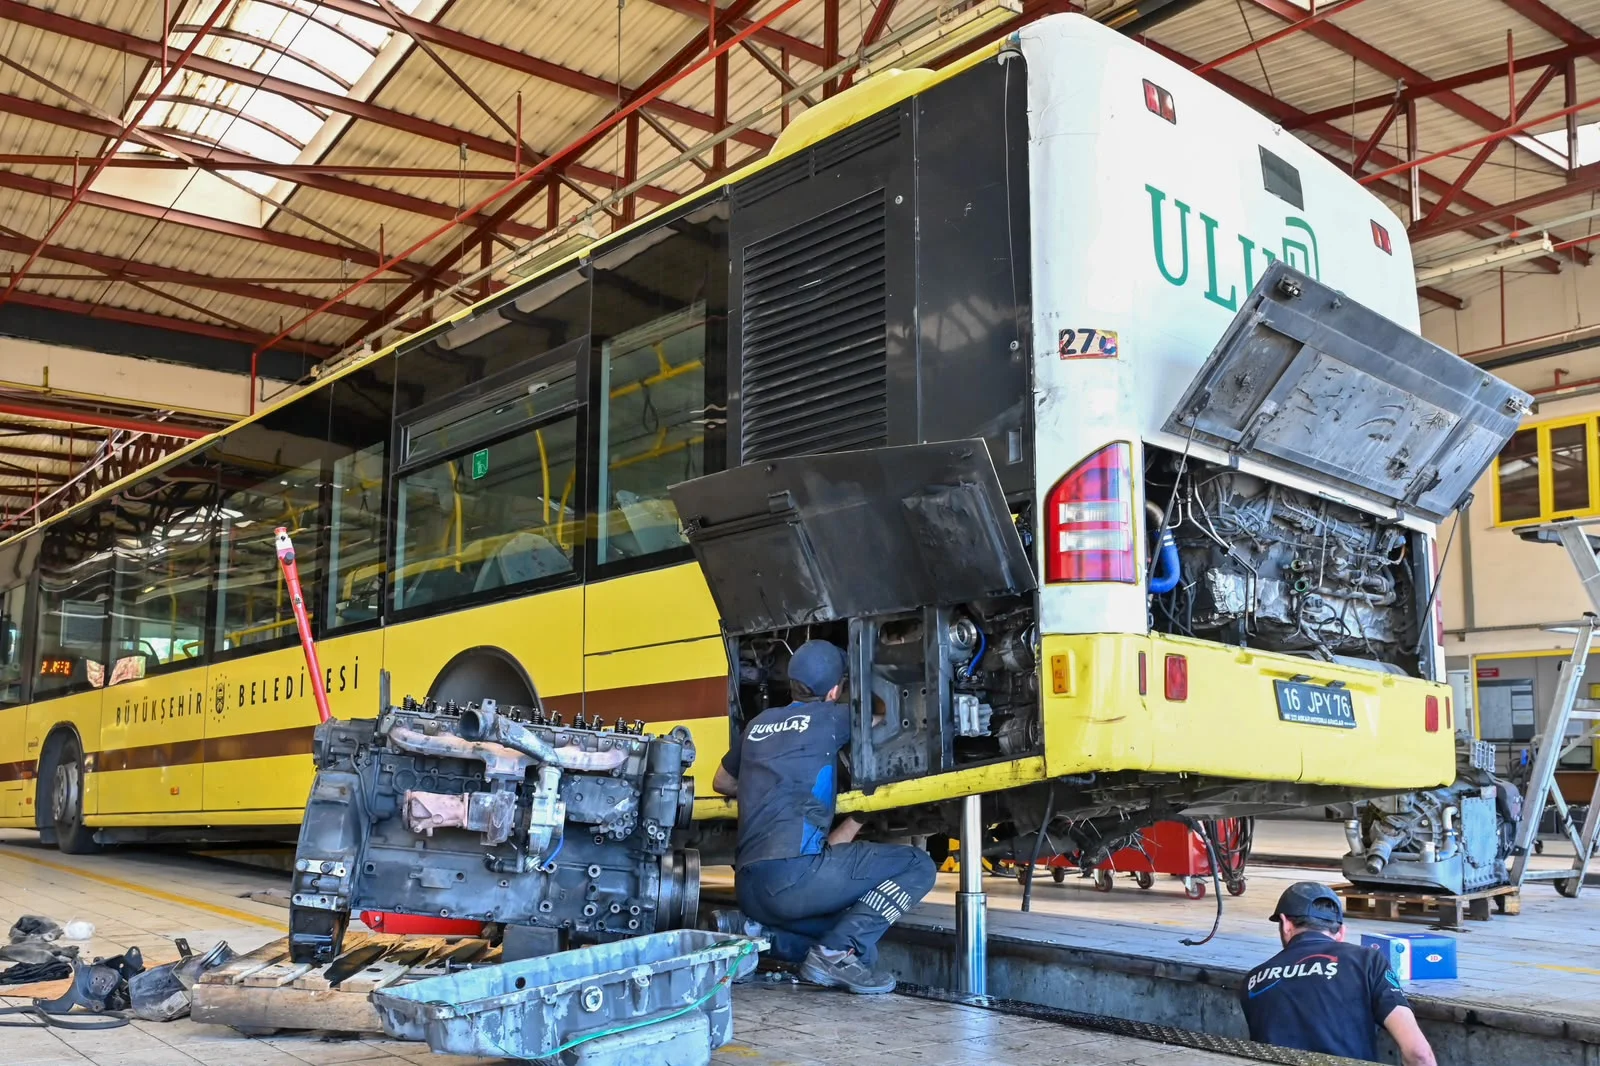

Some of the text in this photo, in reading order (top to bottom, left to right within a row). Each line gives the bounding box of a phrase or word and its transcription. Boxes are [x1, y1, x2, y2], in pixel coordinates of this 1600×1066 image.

[116, 656, 359, 726] BÜYÜKŞEHİR BELEDİESİ
[1284, 687, 1351, 718] 16 JPY 76
[1247, 961, 1338, 991] BURULAŞ
